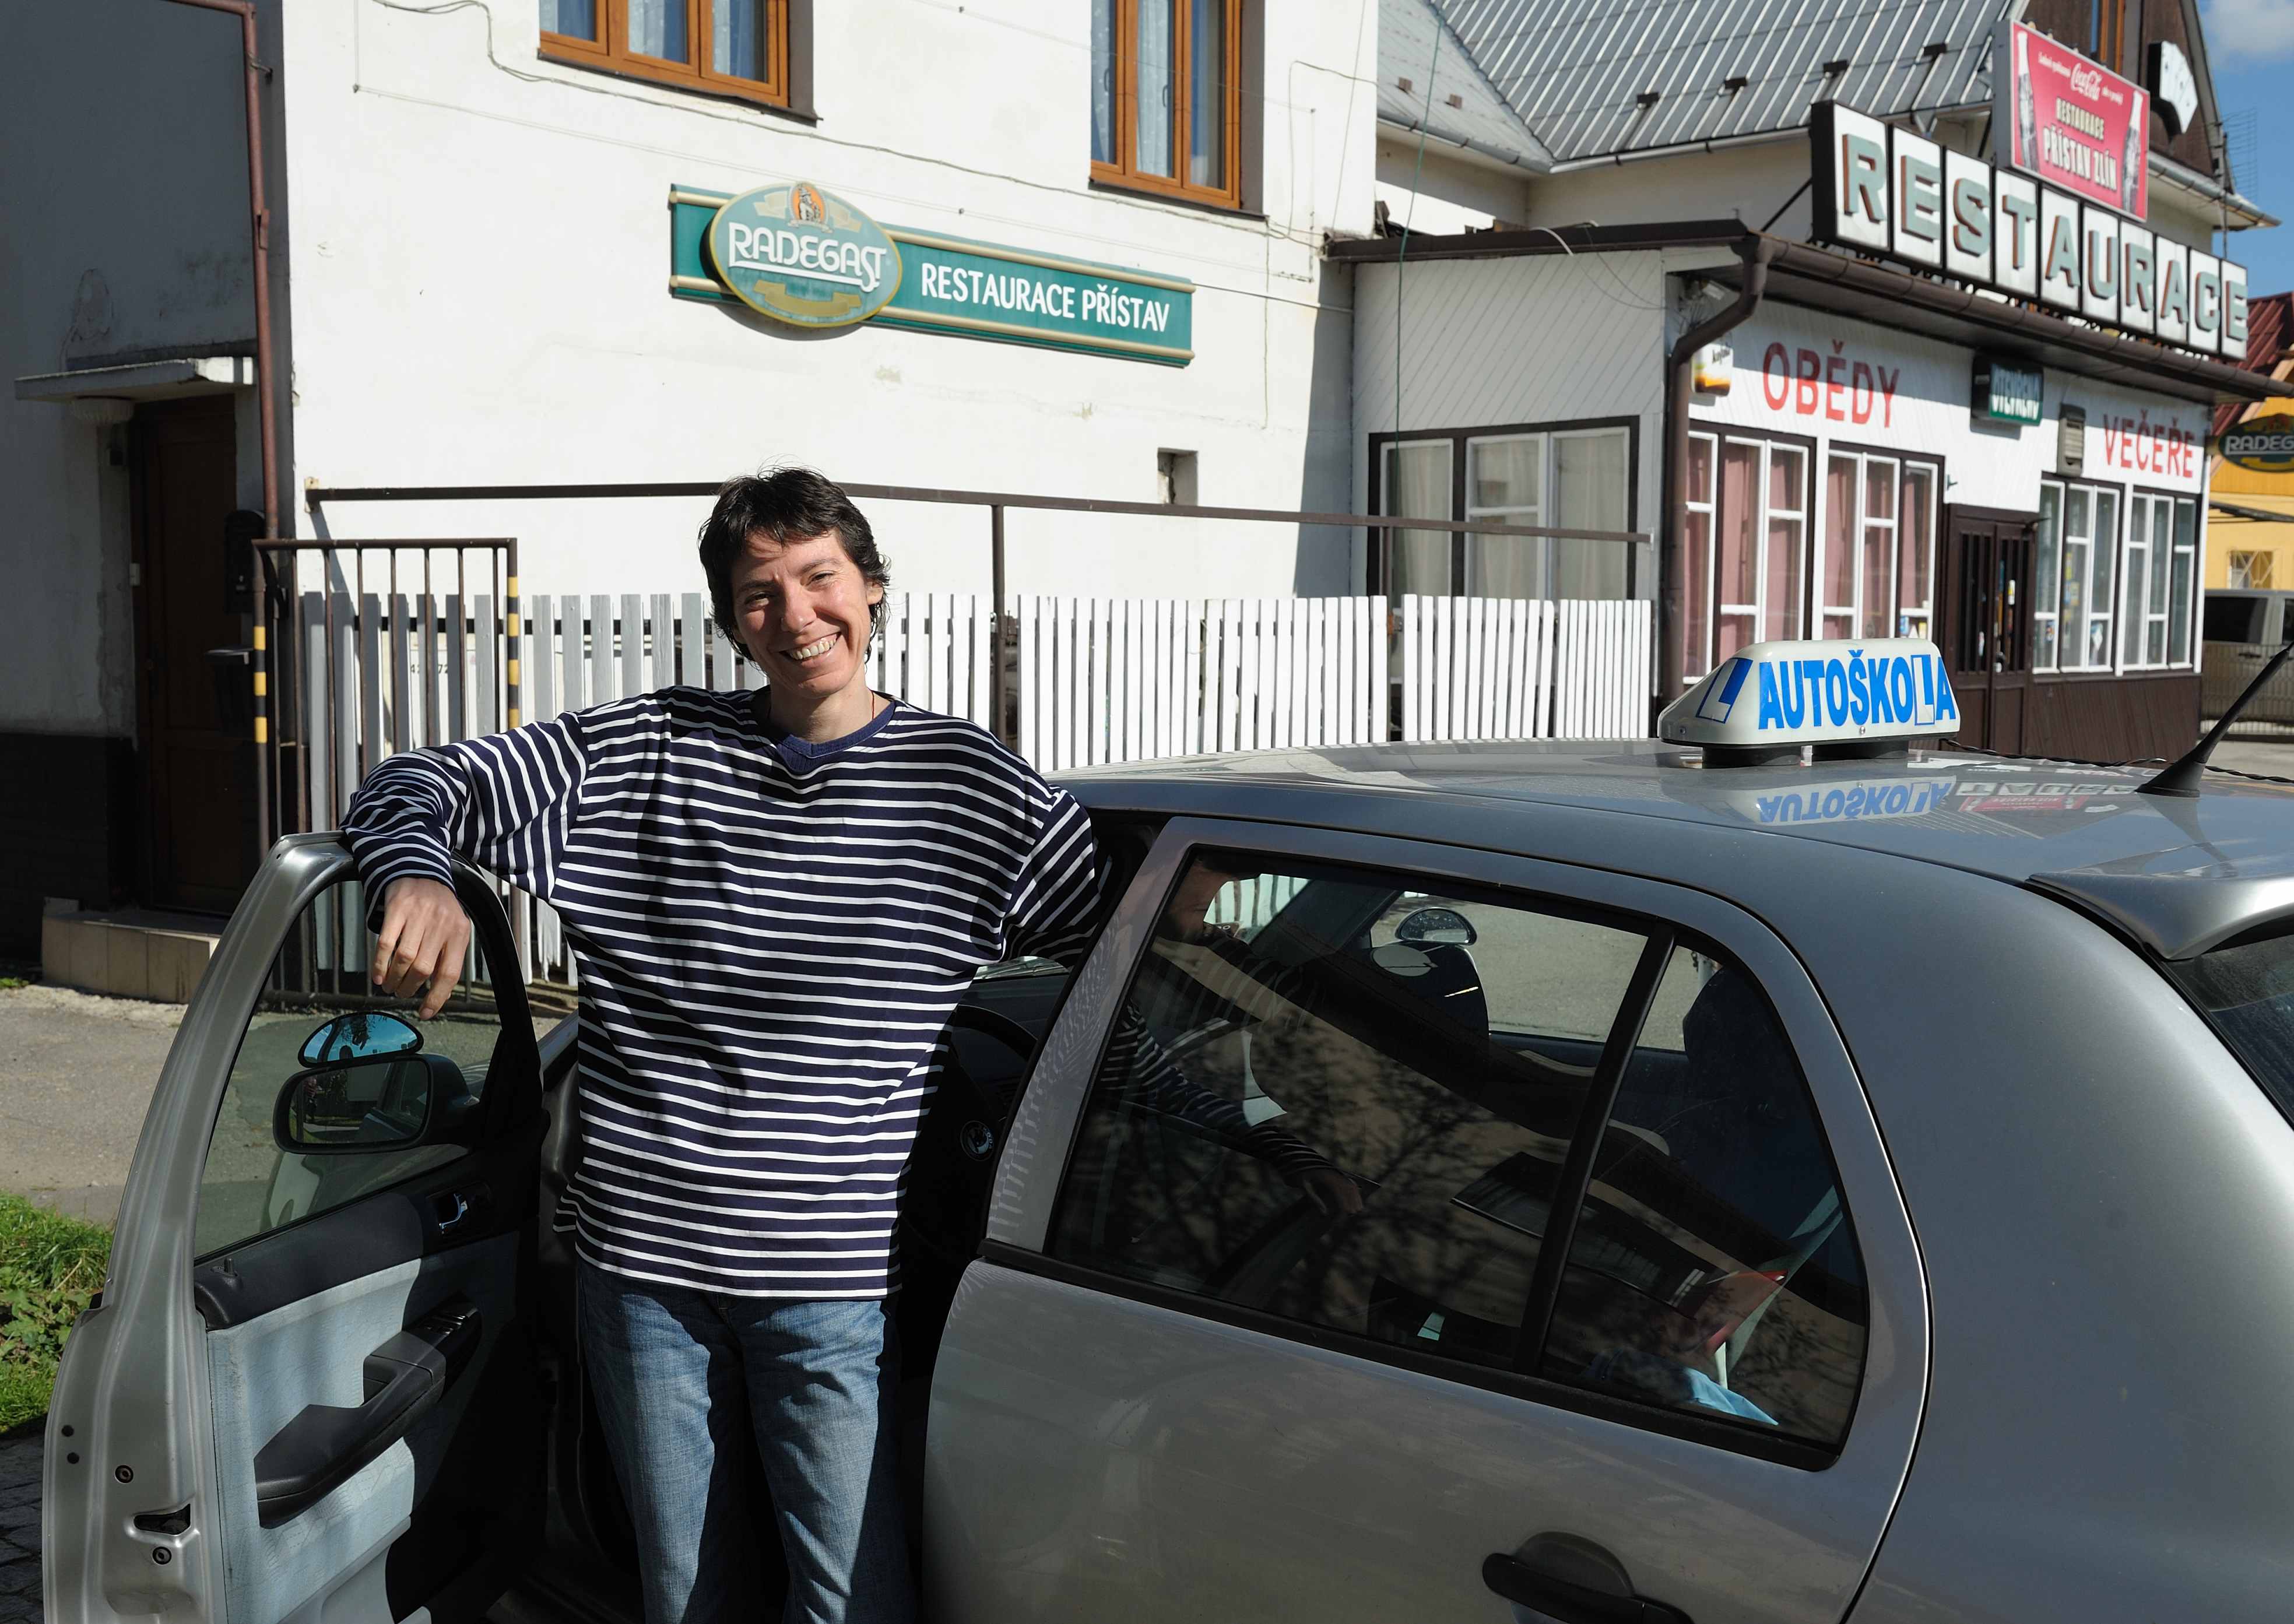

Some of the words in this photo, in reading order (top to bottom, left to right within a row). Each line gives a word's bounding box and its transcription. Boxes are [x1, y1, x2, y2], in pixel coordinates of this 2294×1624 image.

[2056, 97, 2105, 140] RESTAURACE
[2043, 123, 2091, 180] PŘÍSTAV
[2093, 149, 2117, 191] ZLÍN
[728, 221, 887, 293] RADEGAST
[1843, 133, 2248, 343] RESTAURACE
[921, 262, 1074, 319] RESTAURACE
[1081, 283, 1170, 333] PŘÍSTAV
[1763, 338, 1900, 428] OBĚDY
[2103, 409, 2195, 478] VEČEŘE
[1758, 649, 1956, 730] AUTOŠKOLA
